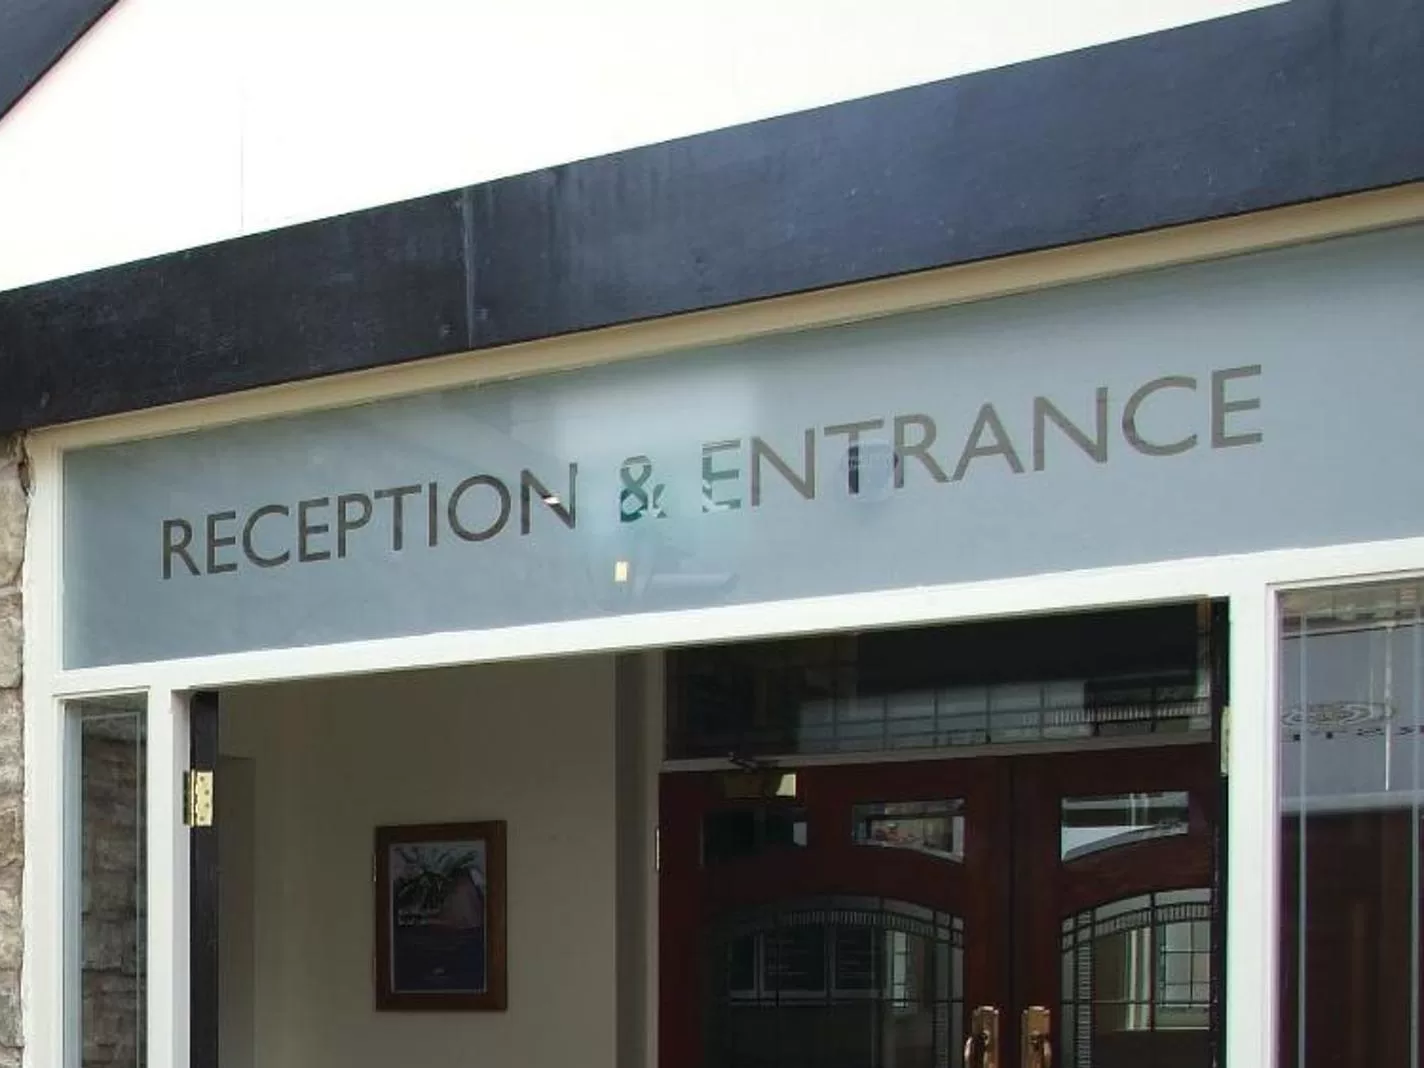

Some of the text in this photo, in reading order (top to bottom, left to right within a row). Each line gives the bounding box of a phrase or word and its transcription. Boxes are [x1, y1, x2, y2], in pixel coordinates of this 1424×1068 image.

[162, 364, 1263, 580] RECEPTION & ENTRANCE
